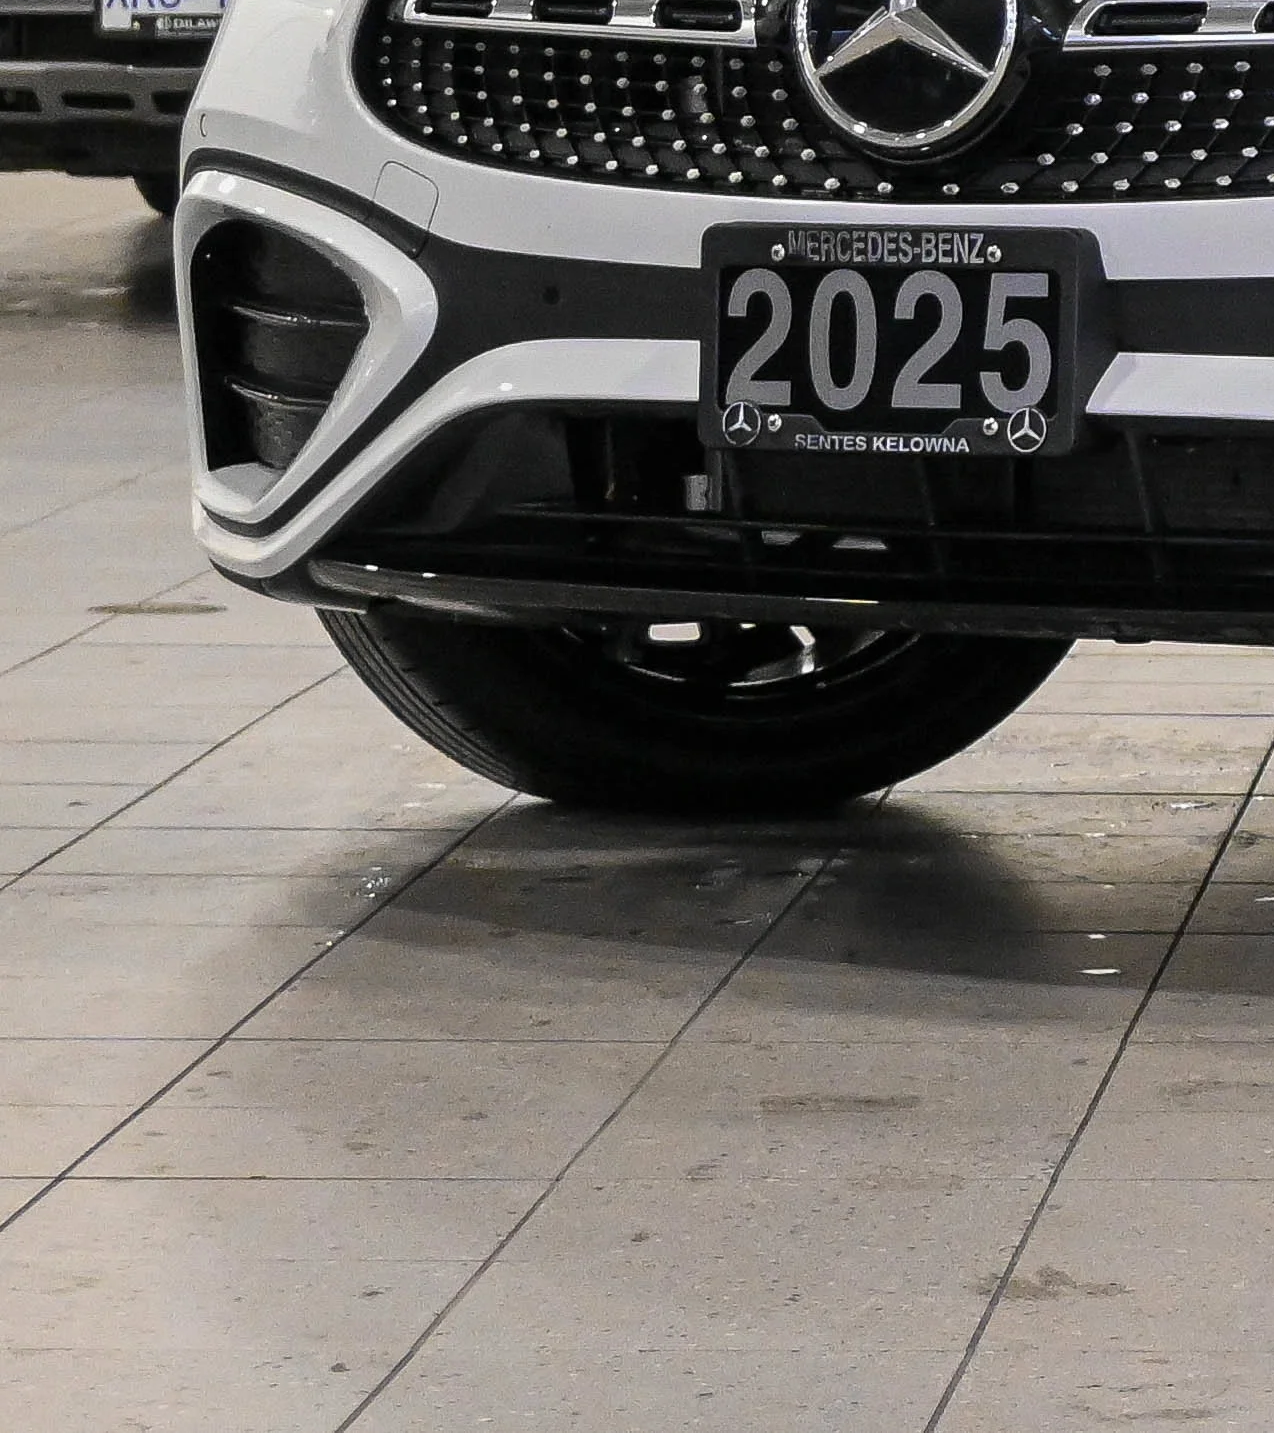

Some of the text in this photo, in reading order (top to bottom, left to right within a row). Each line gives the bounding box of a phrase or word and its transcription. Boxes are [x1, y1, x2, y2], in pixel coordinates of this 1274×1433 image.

[788, 229, 985, 264] MERCEDES-BENZ
[725, 268, 1052, 414] 2025
[795, 433, 970, 454] SENTES KELOWNA
